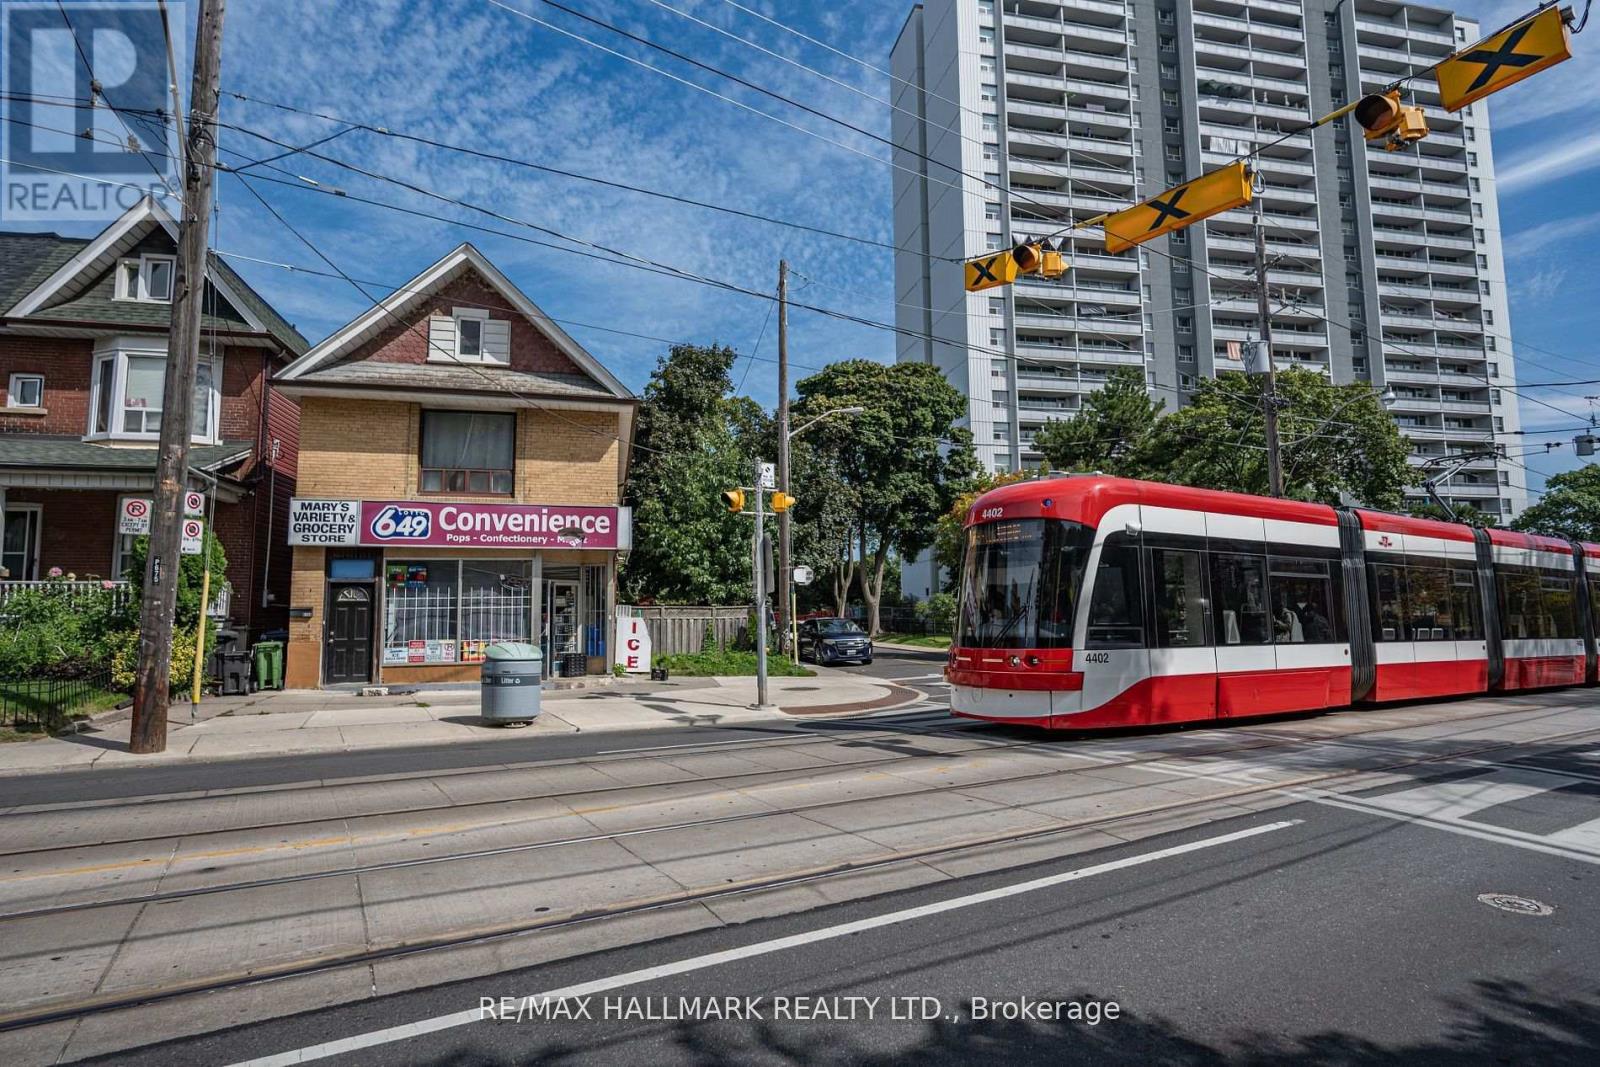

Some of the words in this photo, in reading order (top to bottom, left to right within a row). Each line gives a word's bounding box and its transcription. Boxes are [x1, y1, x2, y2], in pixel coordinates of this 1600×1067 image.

[301, 502, 350, 512] MARY'S
[982, 507, 1004, 519] 4402
[293, 512, 347, 523] VARIETY
[438, 506, 611, 534] Convenience
[293, 523, 354, 534] GROCERY
[301, 534, 346, 543] STORE
[446, 533, 471, 543] Pops
[480, 534, 548, 545] Confectionery
[627, 622, 640, 669] ICE
[1085, 652, 1110, 664] 4402
